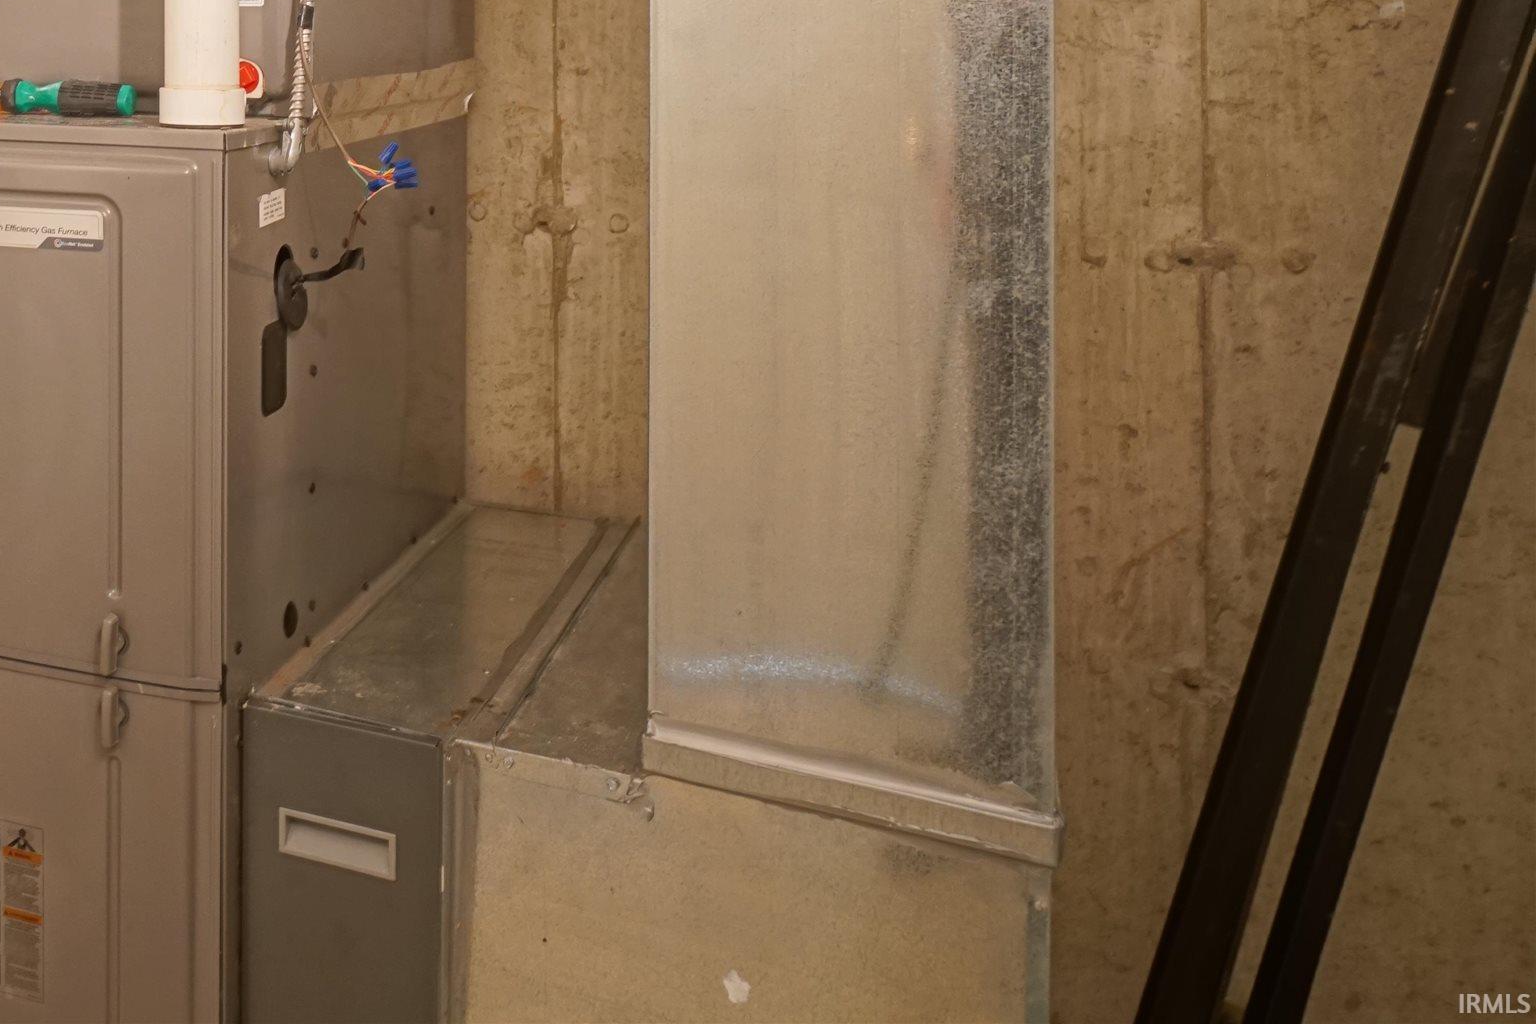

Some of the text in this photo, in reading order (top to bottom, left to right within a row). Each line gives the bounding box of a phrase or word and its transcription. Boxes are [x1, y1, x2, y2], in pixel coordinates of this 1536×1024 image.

[5, 224, 40, 234] Efficiency
[41, 226, 56, 234] Gas
[57, 227, 88, 236] Furnace
